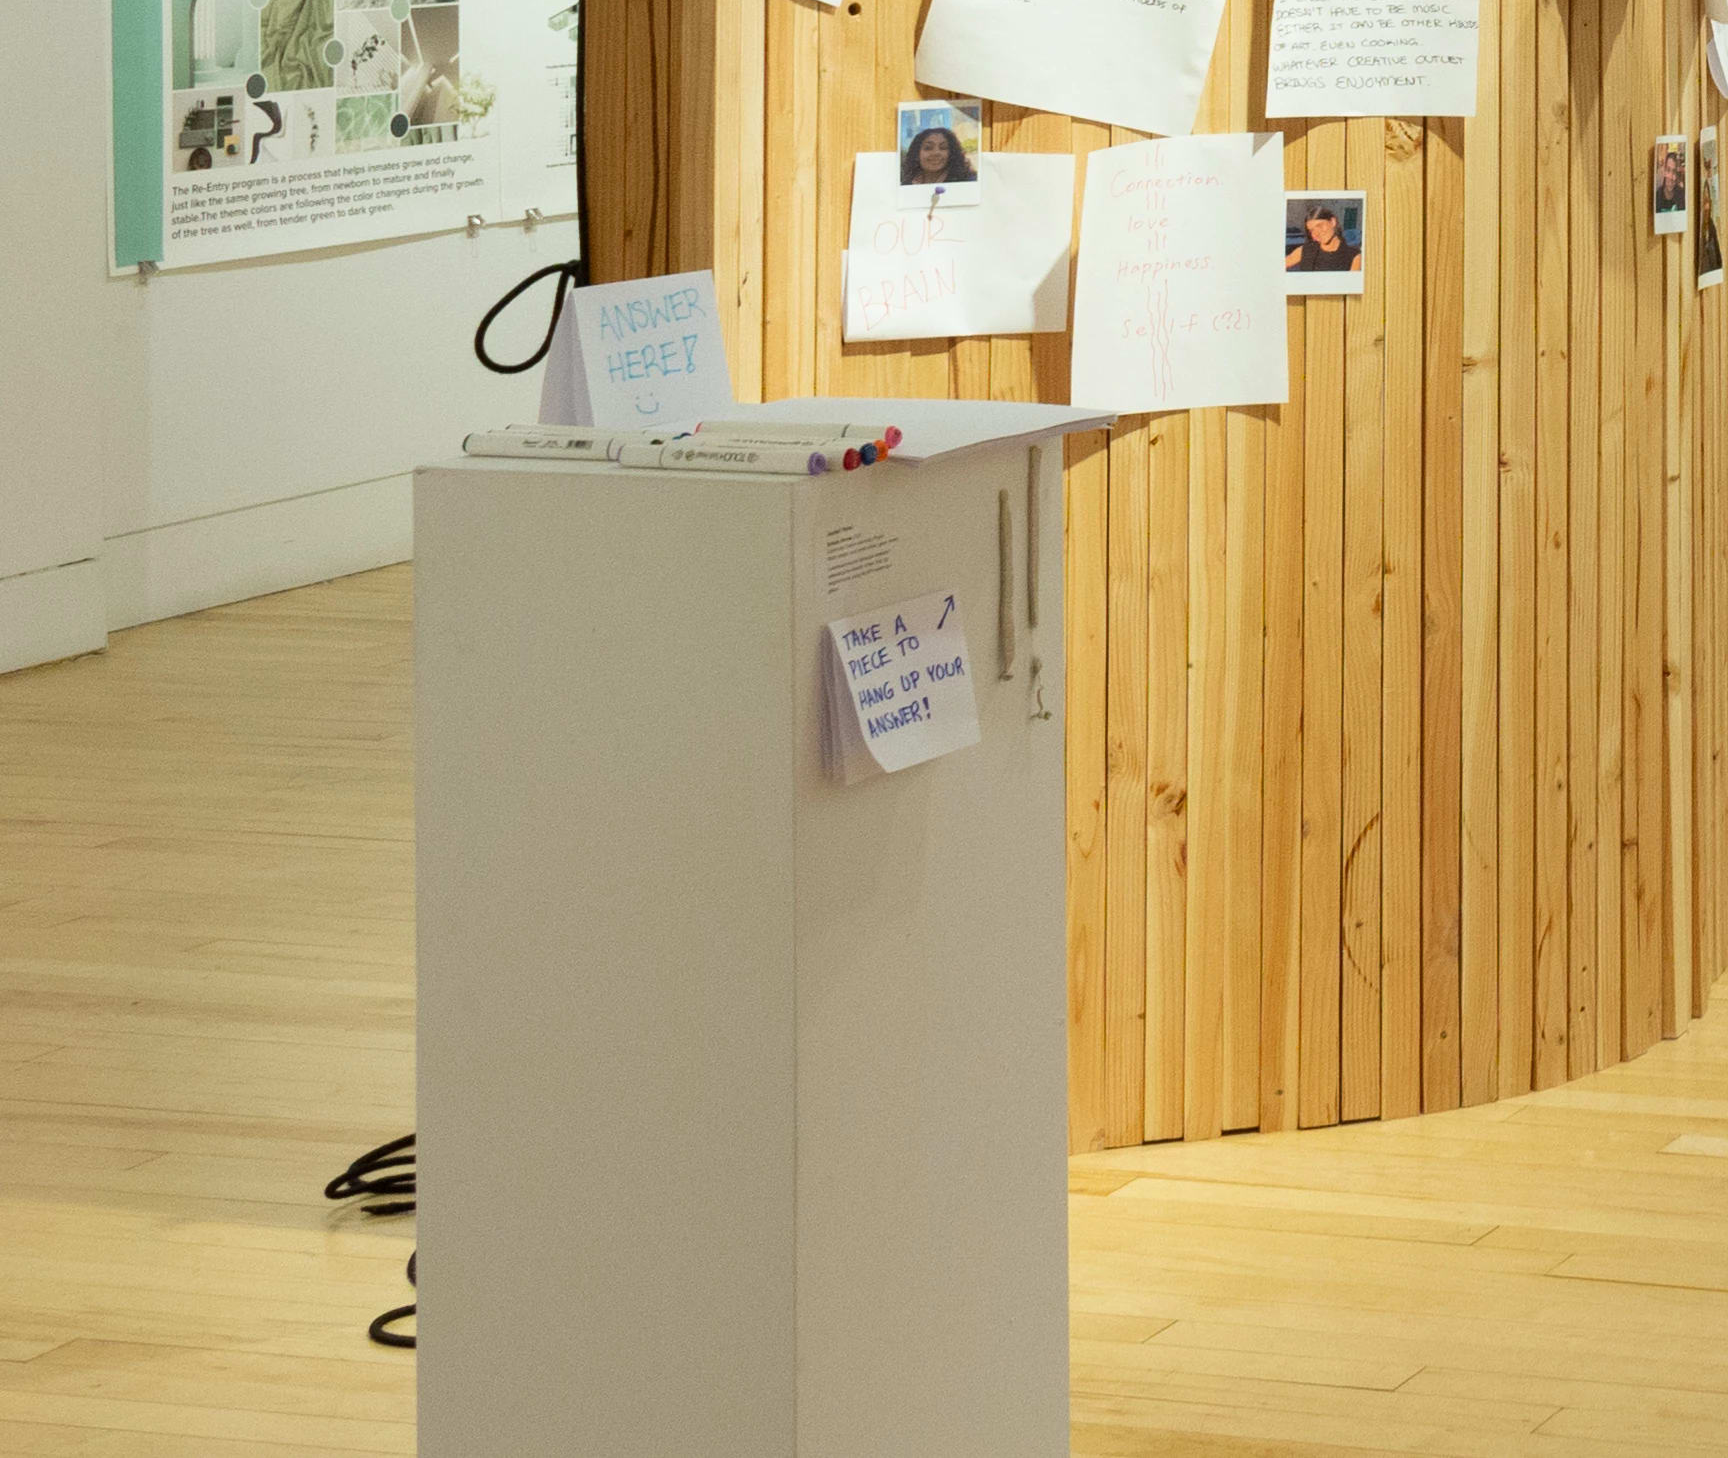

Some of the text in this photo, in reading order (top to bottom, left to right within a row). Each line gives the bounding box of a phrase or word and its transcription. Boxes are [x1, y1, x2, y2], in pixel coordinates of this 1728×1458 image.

[873, 216, 965, 257] OUR
[600, 287, 707, 340] ANSWER
[859, 265, 957, 333] BRAIN
[607, 335, 698, 383] HERE!
[843, 615, 907, 651] TAKE A
[848, 634, 920, 680] PIECE TO
[858, 657, 964, 711] HANG UP YOUR
[868, 697, 931, 740] ANSWER!
